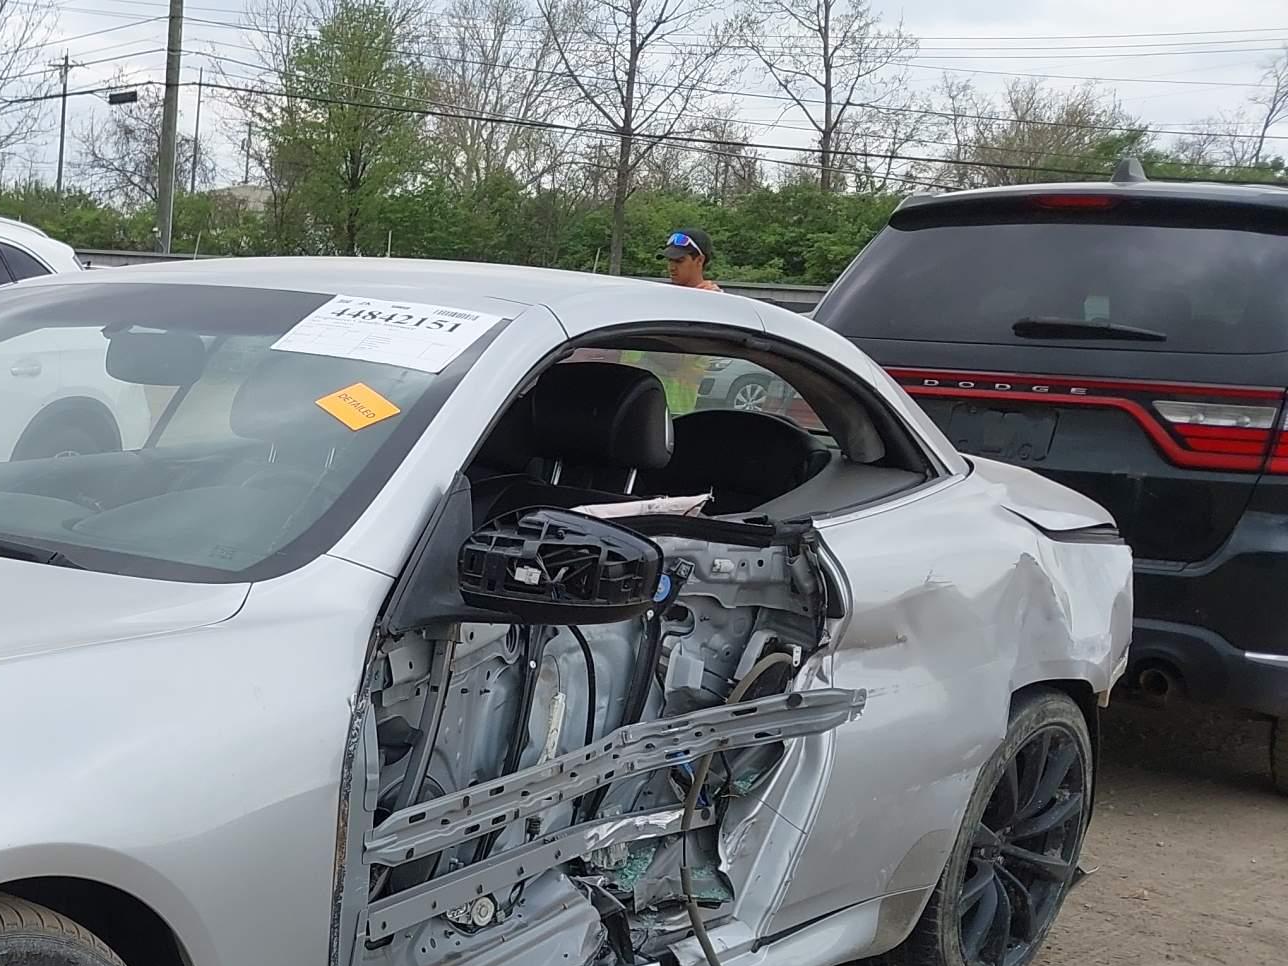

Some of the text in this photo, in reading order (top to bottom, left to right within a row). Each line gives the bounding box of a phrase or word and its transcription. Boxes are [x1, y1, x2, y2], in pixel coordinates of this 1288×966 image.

[330, 307, 462, 333] 44842151
[923, 378, 1089, 395] DODGE
[338, 392, 377, 419] DETAILED
